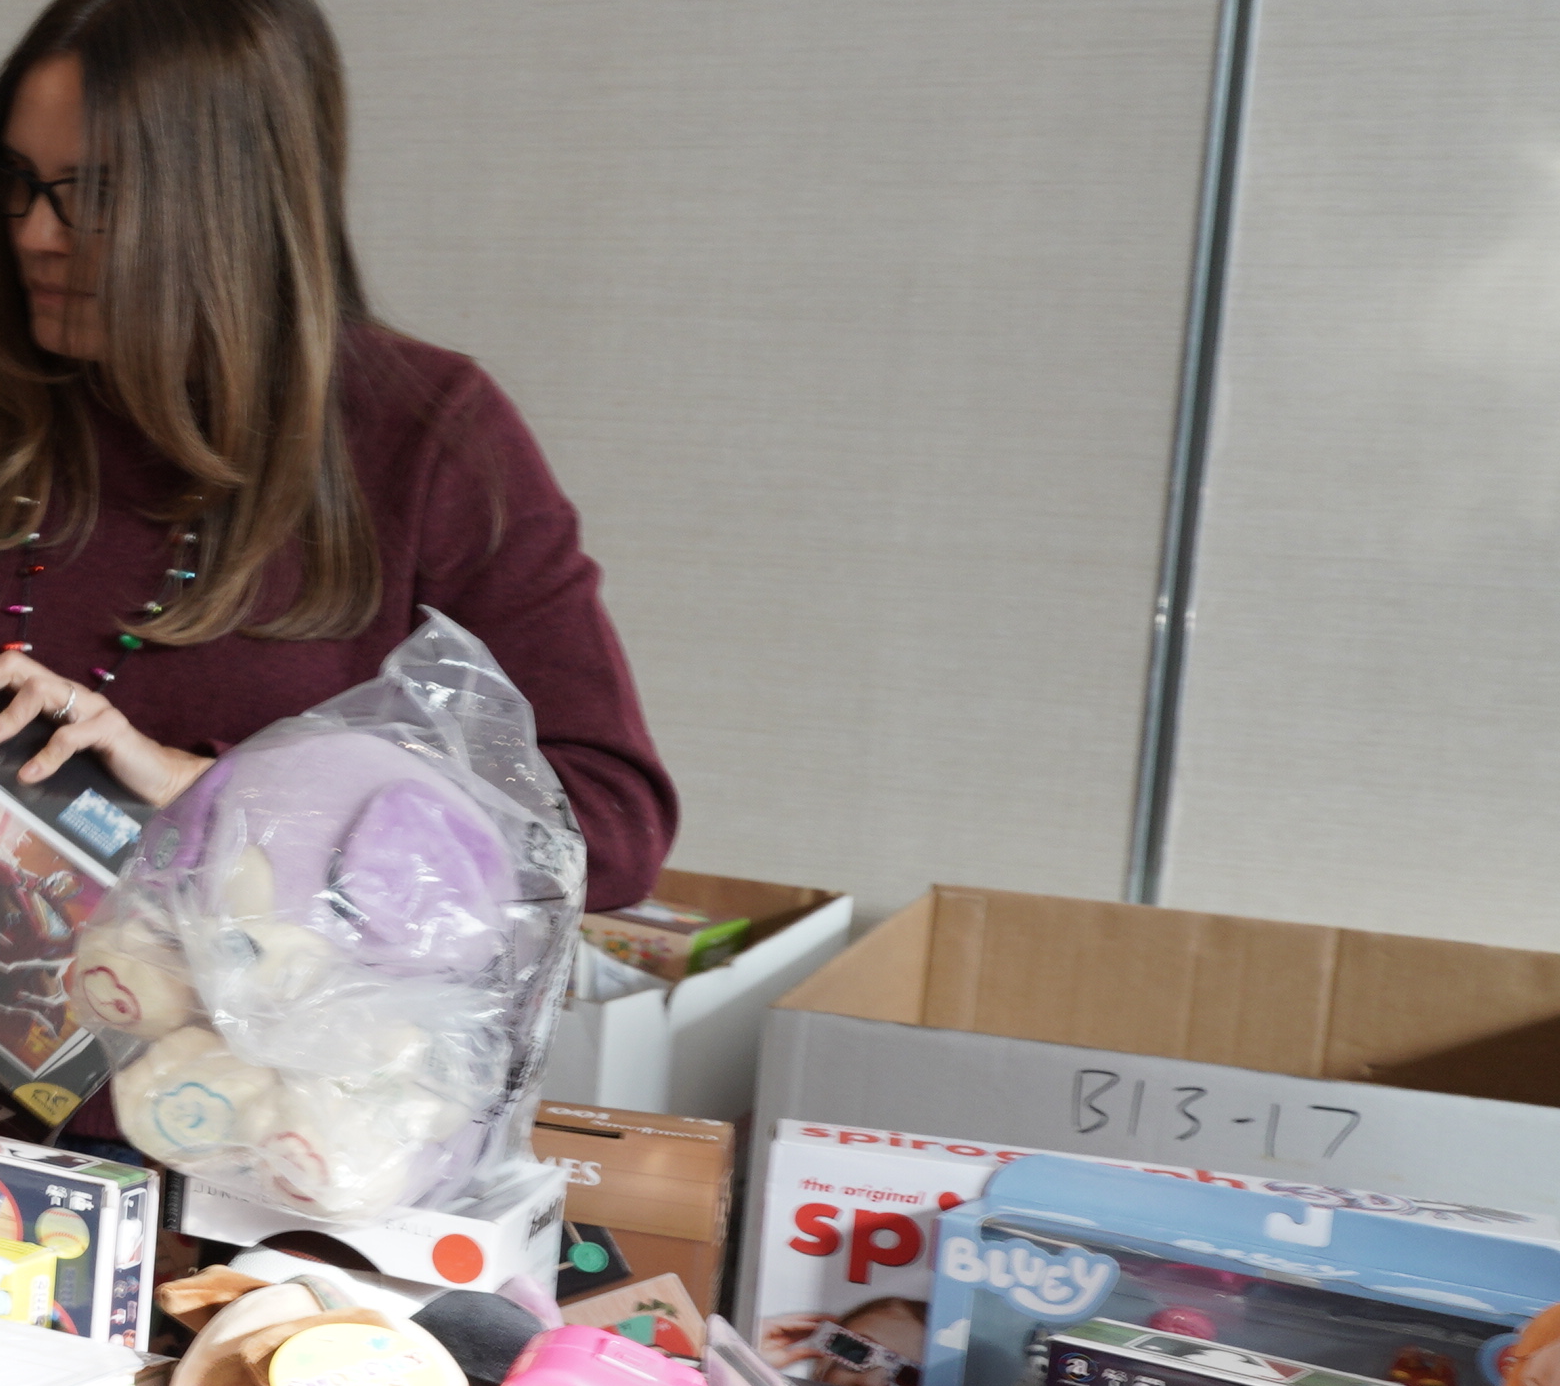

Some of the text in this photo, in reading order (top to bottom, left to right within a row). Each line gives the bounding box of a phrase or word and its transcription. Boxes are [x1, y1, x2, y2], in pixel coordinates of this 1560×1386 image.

[1070, 1069, 1362, 1160] B13-17
[801, 1177, 925, 1209] the original
[941, 1236, 1112, 1315] BLUEY
